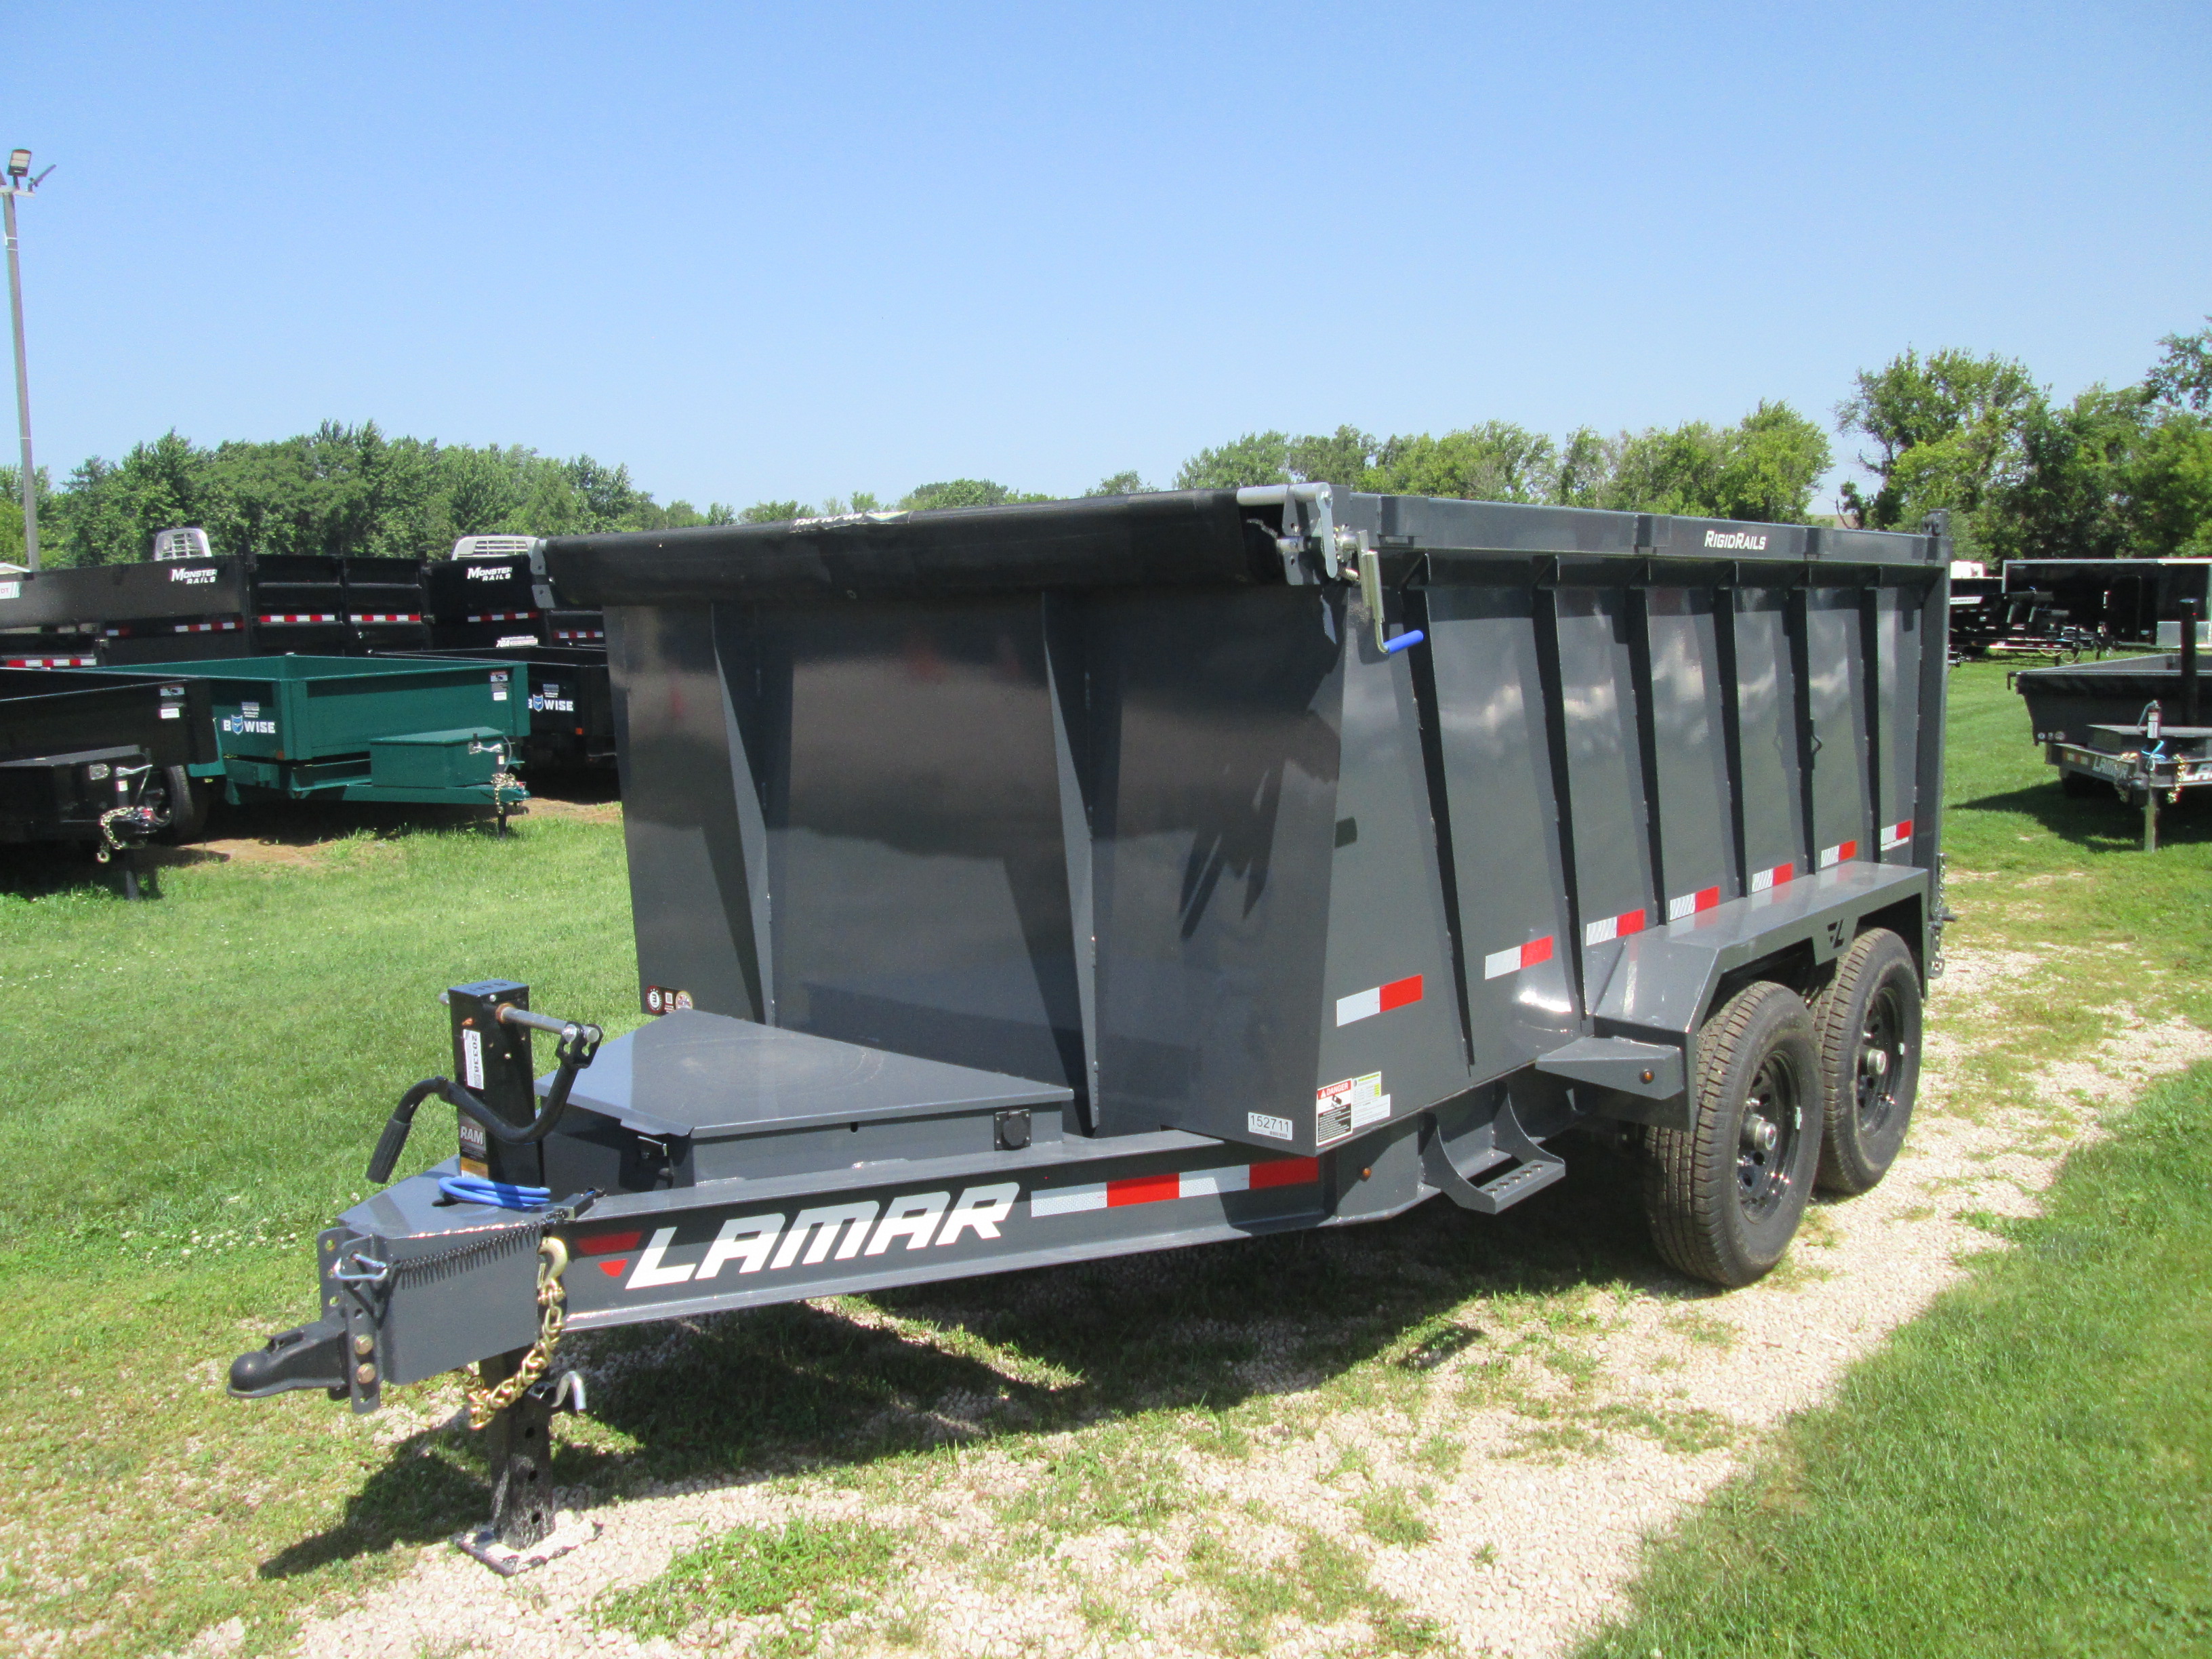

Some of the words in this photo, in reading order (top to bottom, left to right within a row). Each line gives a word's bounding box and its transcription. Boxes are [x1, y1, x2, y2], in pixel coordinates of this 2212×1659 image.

[1704, 530, 1766, 550] RIGIDRAILS
[171, 568, 218, 581] MONSTER
[186, 576, 216, 584] RAILS
[468, 567, 512, 579] MONSTER
[482, 573, 511, 581] RAILS
[1326, 1082, 1349, 1096] DANGER
[1250, 1114, 1289, 1132] 152711
[460, 1126, 483, 1145] RAM
[625, 1182, 1020, 1290] LAMAR
